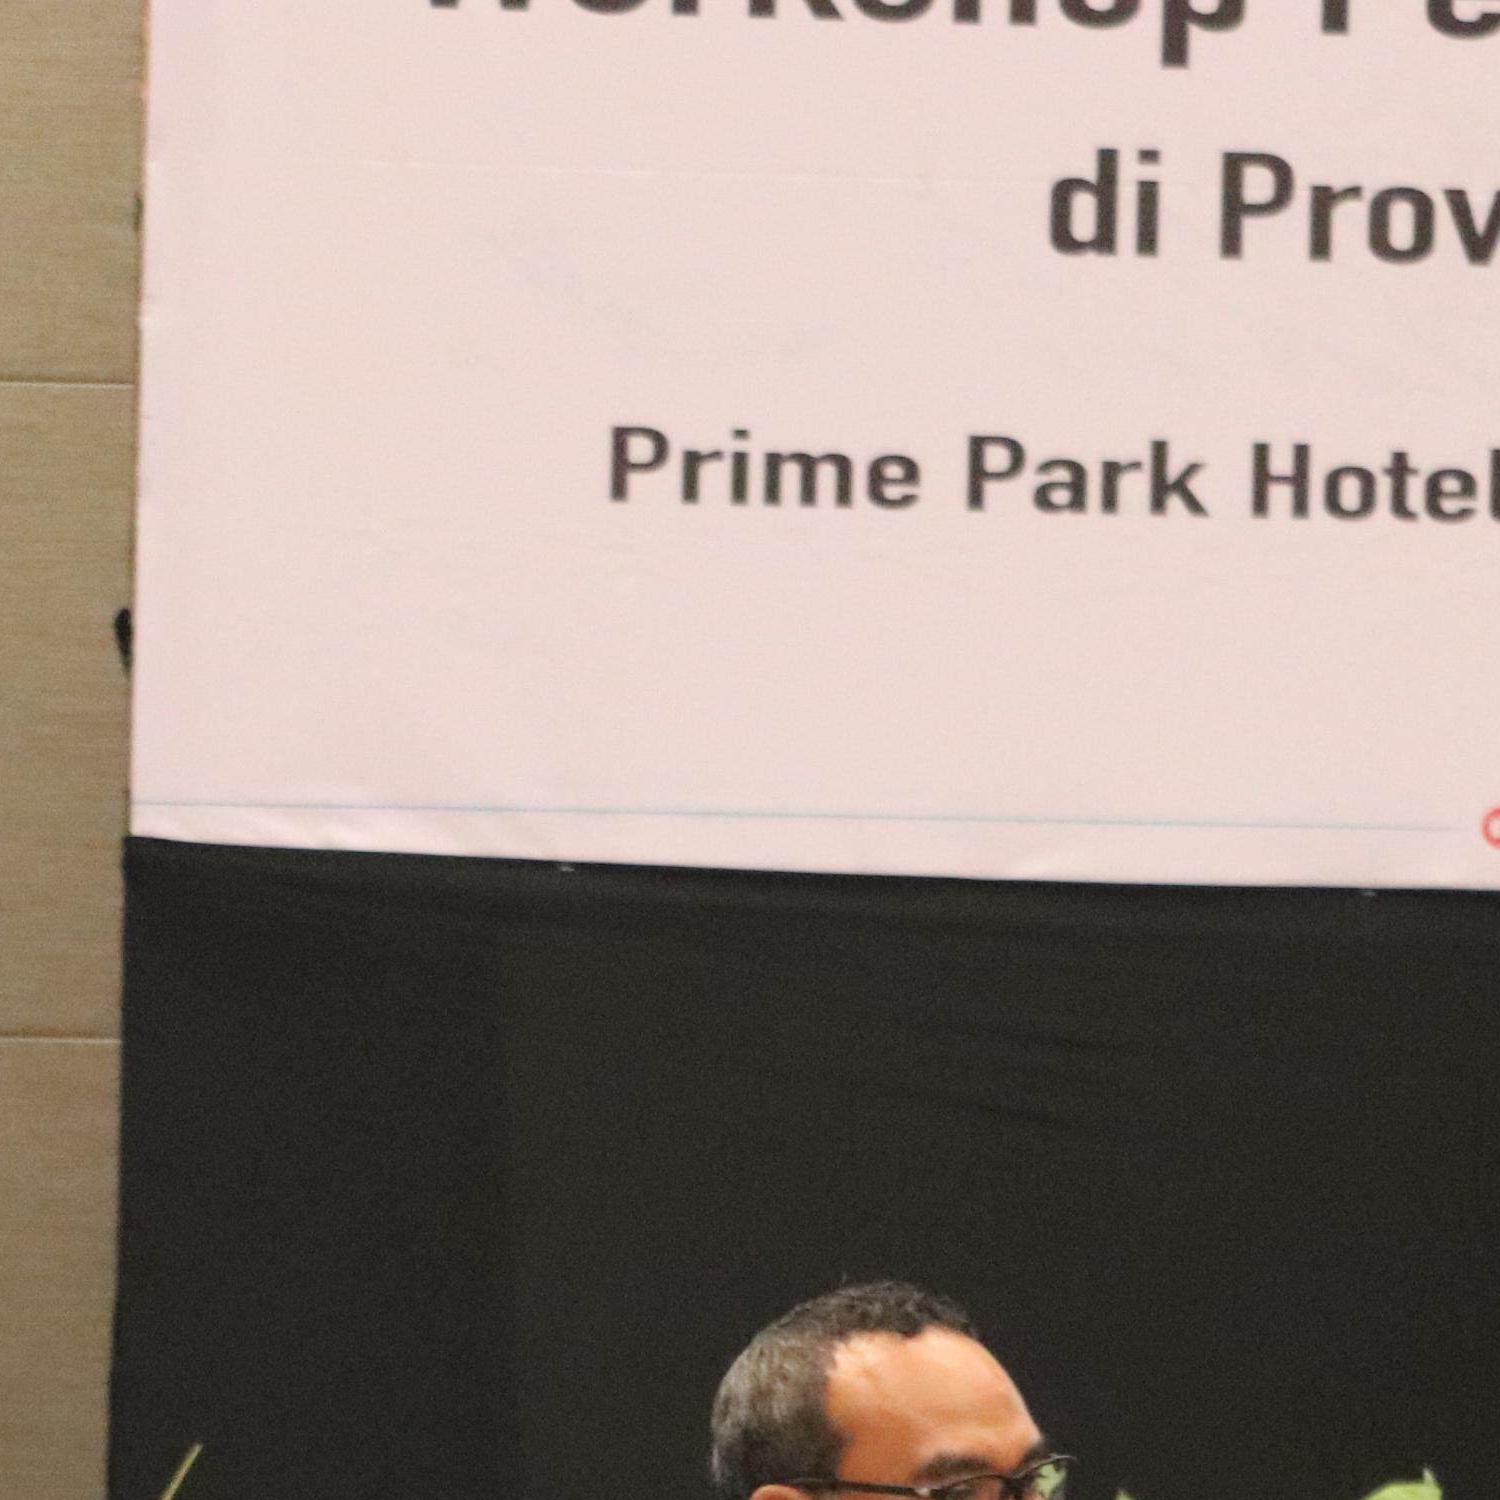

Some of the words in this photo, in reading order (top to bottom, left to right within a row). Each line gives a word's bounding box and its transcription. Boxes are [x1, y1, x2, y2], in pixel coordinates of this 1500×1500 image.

[1049, 147, 1161, 257] di
[609, 425, 921, 510] Prime
[966, 434, 1208, 517] Park
